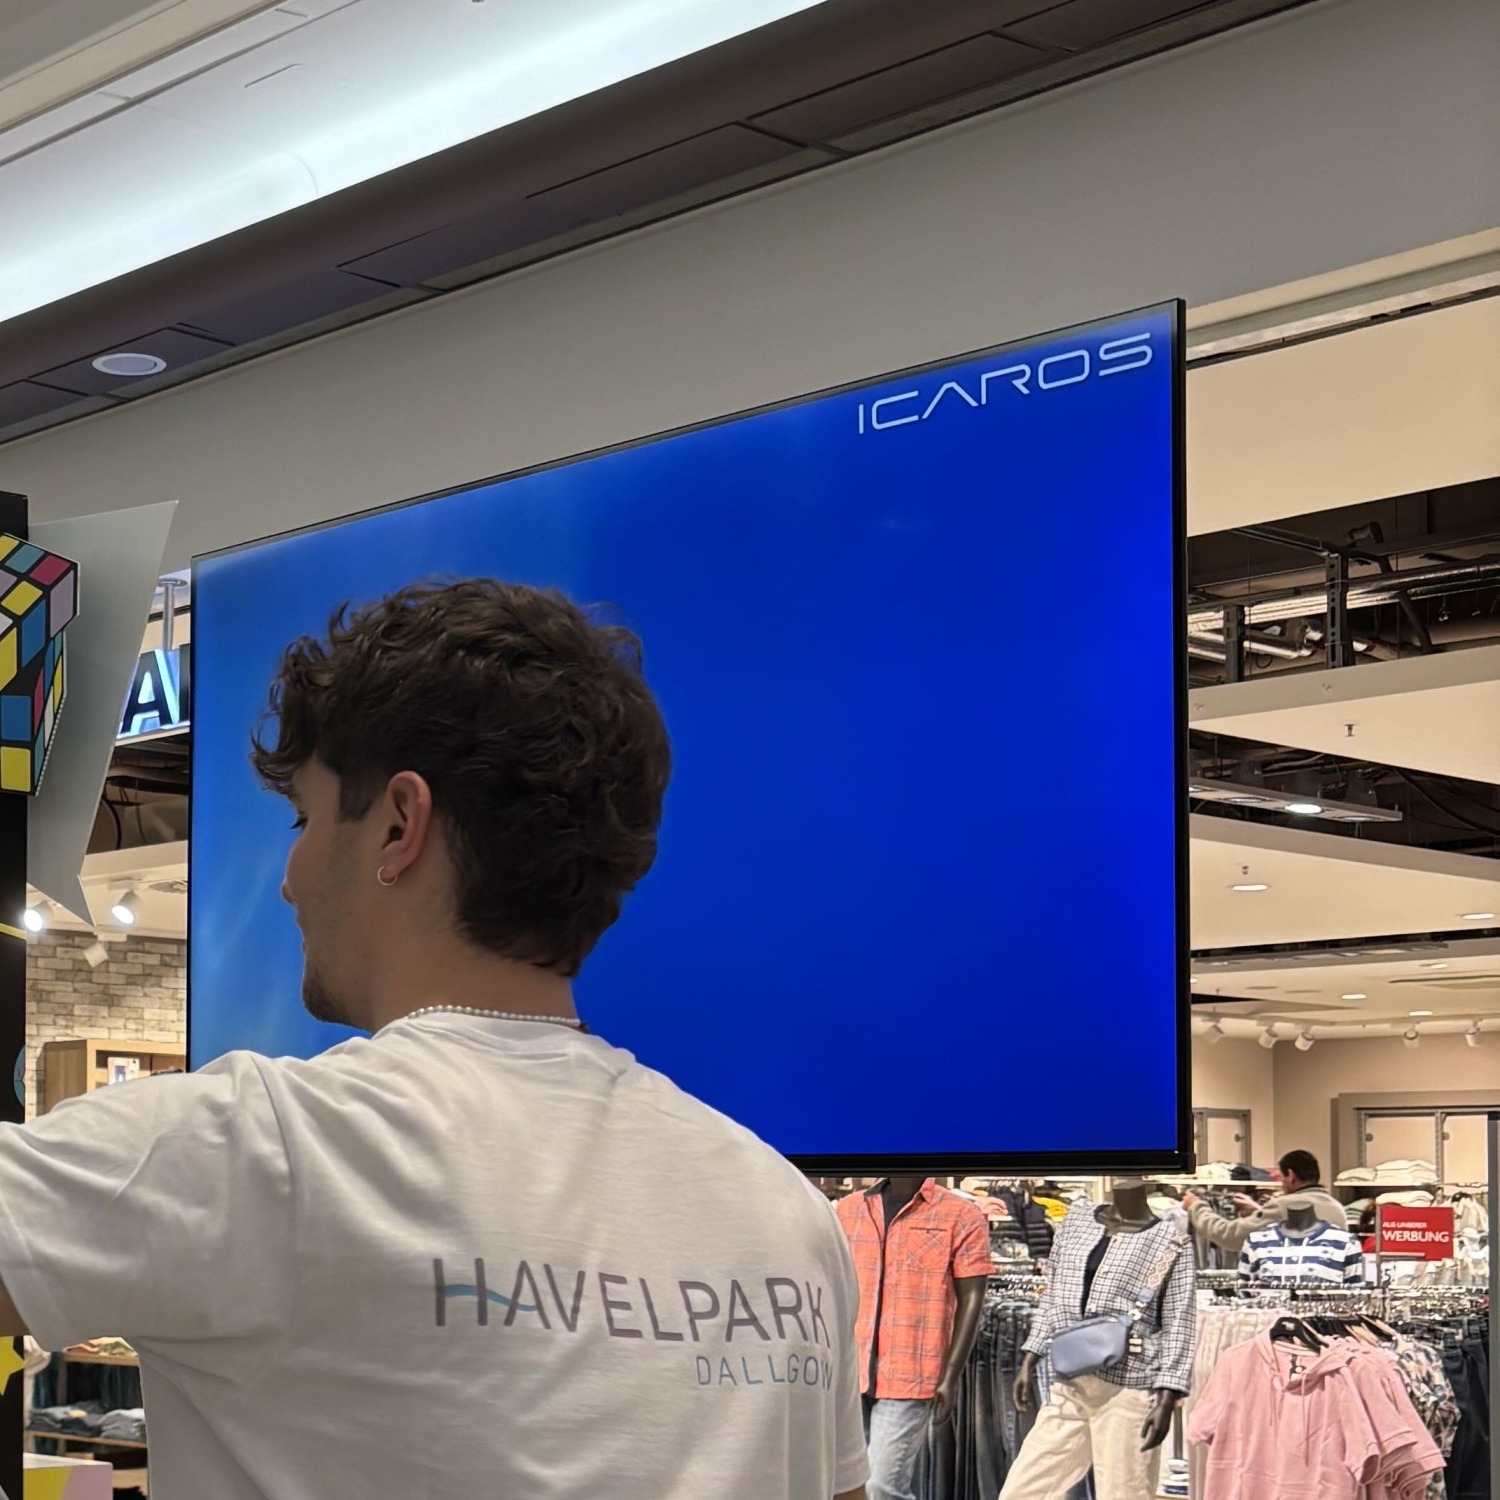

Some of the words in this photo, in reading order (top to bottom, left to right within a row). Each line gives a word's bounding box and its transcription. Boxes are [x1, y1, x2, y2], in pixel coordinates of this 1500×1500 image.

[858, 332, 1153, 435] ICAROS
[1381, 1230, 1450, 1243] WERBUNG
[433, 1258, 831, 1348] HAVELPARK
[696, 1353, 832, 1390] DALLGOW
